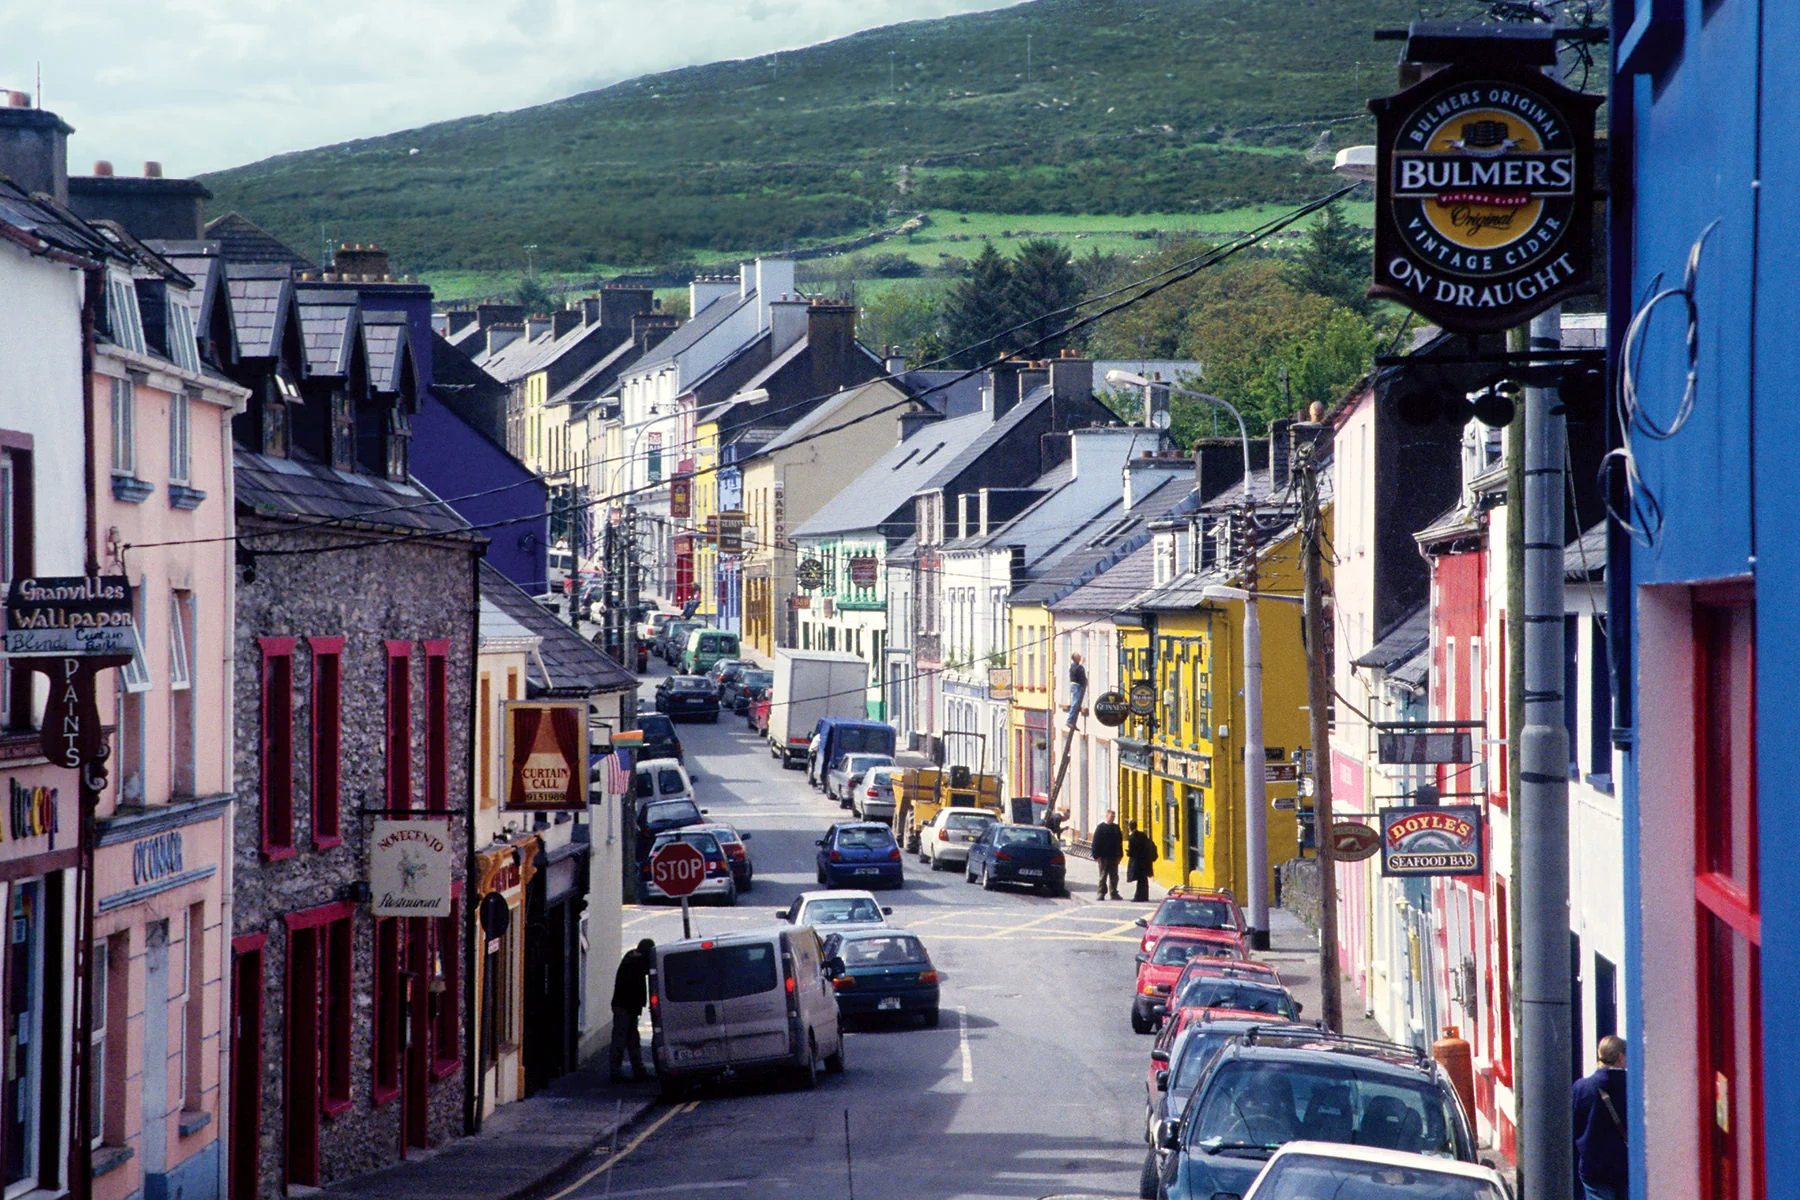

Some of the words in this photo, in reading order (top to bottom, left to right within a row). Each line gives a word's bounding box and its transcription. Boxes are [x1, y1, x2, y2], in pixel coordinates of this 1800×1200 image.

[1409, 90, 1481, 143] BULMERS
[1489, 89, 1560, 141] ORIGINAL
[1401, 158, 1572, 190] BULMERS
[1450, 206, 1519, 237] Original
[1408, 217, 1493, 271] VINTAGE
[1505, 217, 1561, 265] CIDER
[1389, 257, 1433, 294] ON
[1434, 252, 1577, 308] DRAUGHT
[14, 607, 132, 629] Wallpaper
[63, 658, 81, 768] PAINTS
[522, 768, 569, 779] CURTAIN
[532, 779, 560, 789] CALL
[1390, 815, 1471, 839] DOYLE'S
[377, 829, 445, 853] NOVECENTO
[656, 858, 702, 881] STOP
[1391, 856, 1447, 868] SEAFOOD
[1449, 855, 1474, 866] BAR
[378, 892, 442, 909] Restaurant
